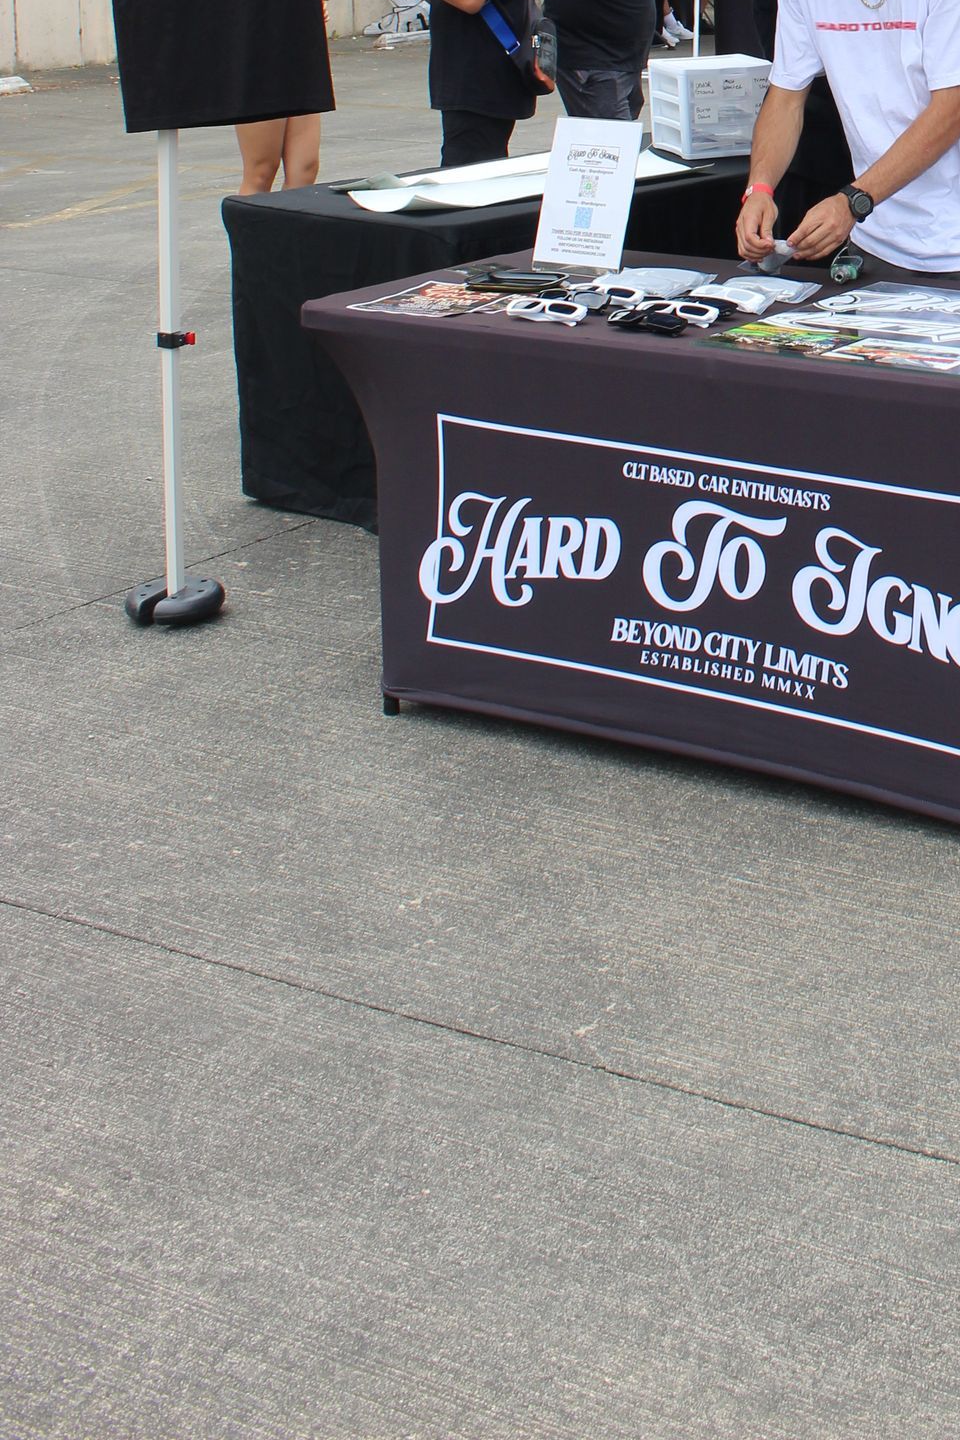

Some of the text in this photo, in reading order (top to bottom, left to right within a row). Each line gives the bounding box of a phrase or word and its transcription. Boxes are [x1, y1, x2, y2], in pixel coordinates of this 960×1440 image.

[861, 21, 882, 32] TO
[622, 461, 831, 512] CLT BASED CAR ENTHUSIASTS
[418, 491, 622, 608] HARD
[642, 498, 787, 612] TO
[610, 616, 850, 690] BEYOND CITY LIMITS
[640, 650, 816, 701] ESTABLISHED MMXX
